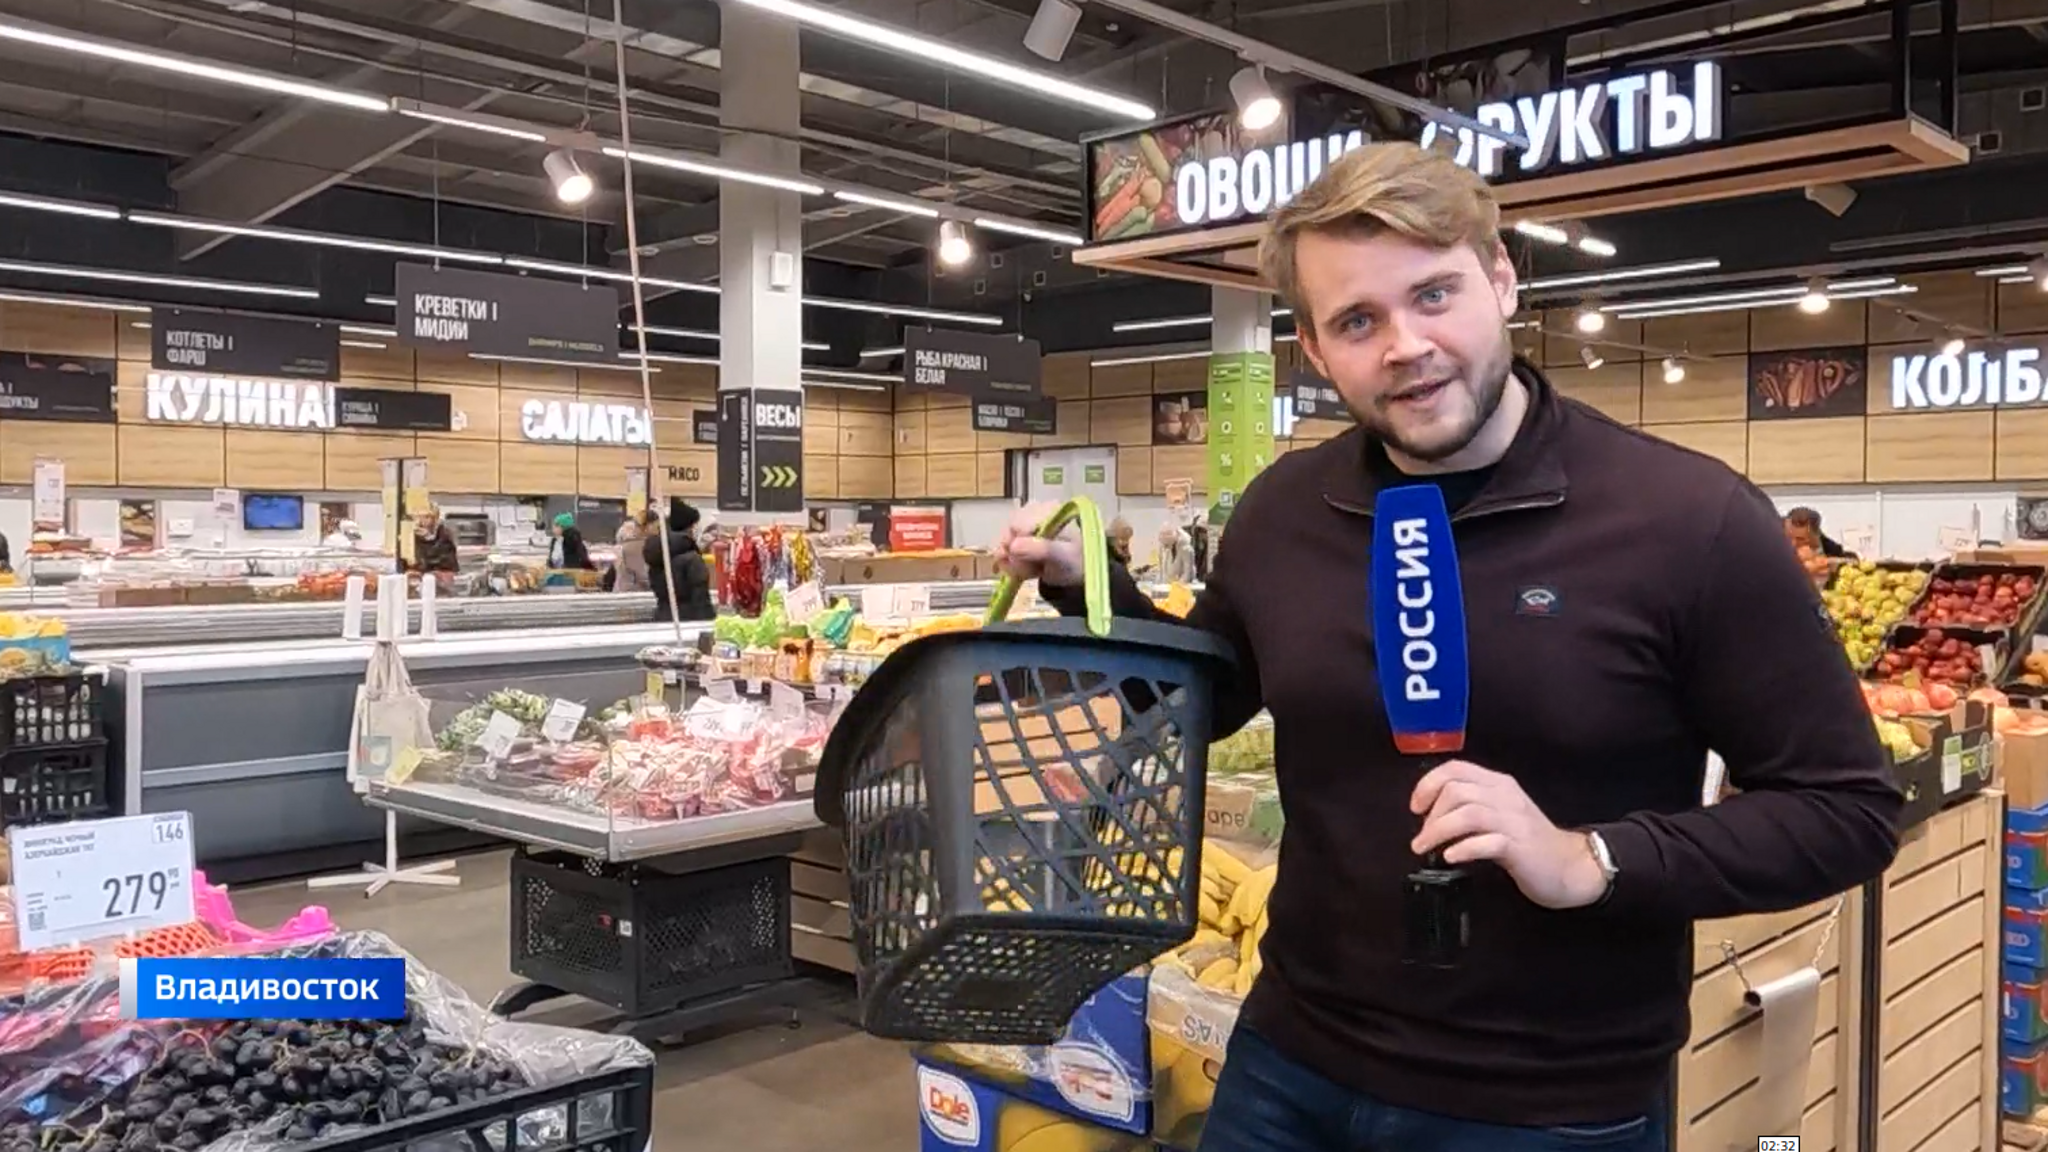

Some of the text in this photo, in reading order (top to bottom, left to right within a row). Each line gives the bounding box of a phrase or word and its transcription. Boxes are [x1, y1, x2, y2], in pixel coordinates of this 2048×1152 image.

[415, 294, 487, 320] КРЕВЕТКИ
[166, 330, 224, 349] КОТЛЕТЫ
[415, 317, 469, 341] МИДИИ
[166, 349, 206, 366] ФАРШ
[915, 350, 981, 371] РЫБА КРАСНАЯ
[915, 367, 945, 385] БЕЛАЯ
[522, 399, 653, 444] САЛАТЫ
[755, 403, 800, 427] ВЕСЫ
[668, 466, 700, 482] МЯСО
[1393, 518, 1440, 701] РОССИЯ
[156, 822, 184, 842] 146
[103, 871, 167, 918] 279
